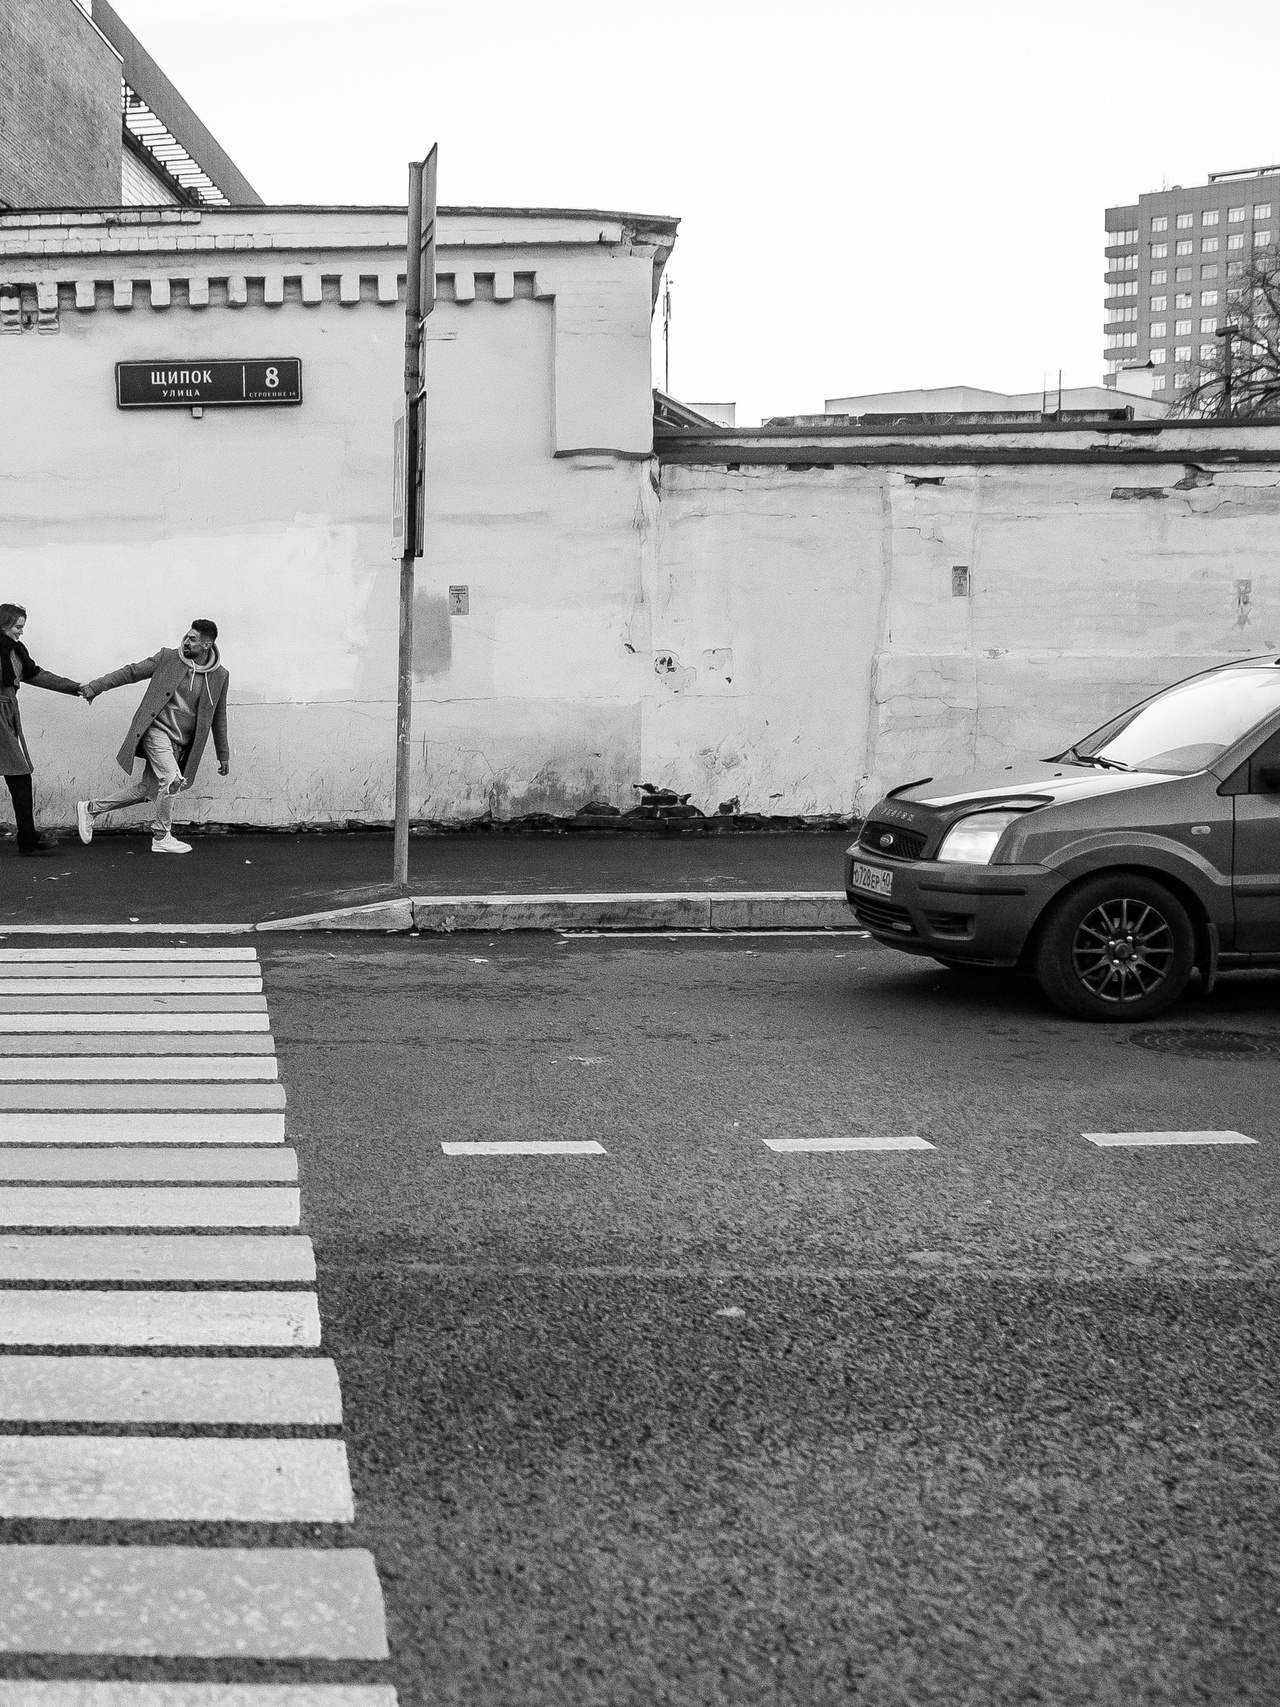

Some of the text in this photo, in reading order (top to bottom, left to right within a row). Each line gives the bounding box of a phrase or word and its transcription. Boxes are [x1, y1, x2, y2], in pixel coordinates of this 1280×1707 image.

[151, 370, 213, 386] ЩИПОК
[265, 367, 279, 388] 8
[162, 389, 201, 398] УЛИЦА
